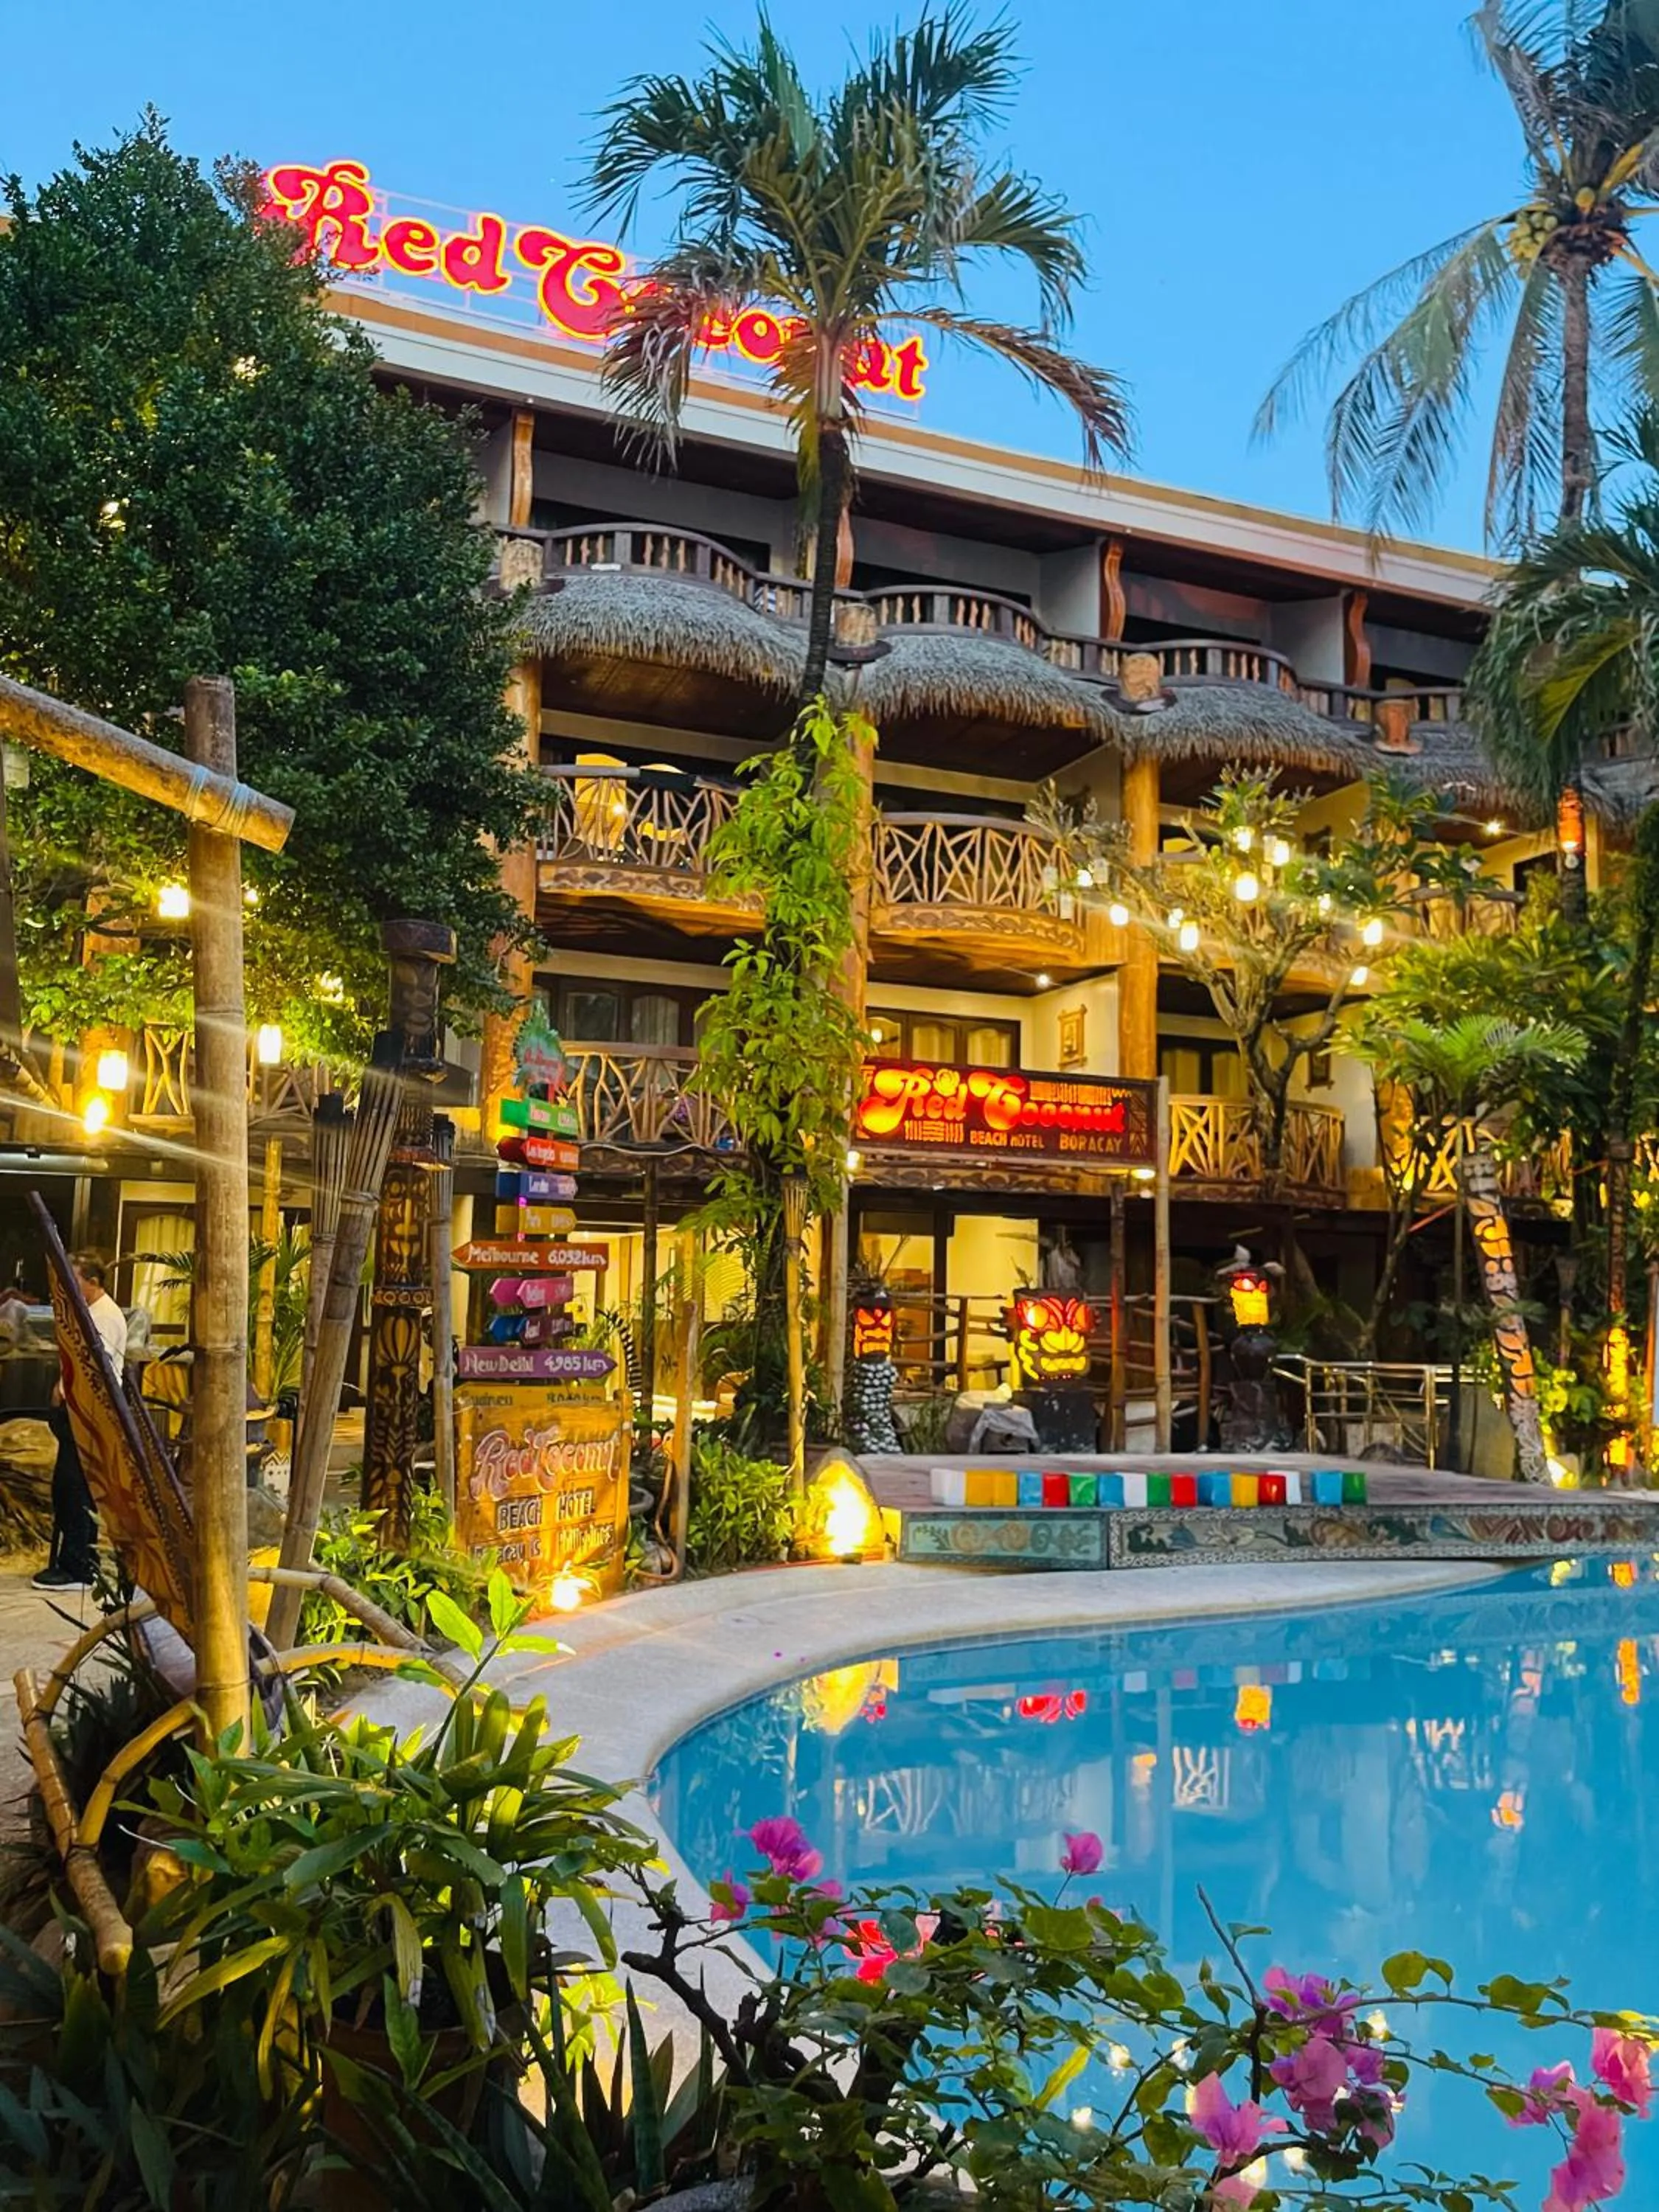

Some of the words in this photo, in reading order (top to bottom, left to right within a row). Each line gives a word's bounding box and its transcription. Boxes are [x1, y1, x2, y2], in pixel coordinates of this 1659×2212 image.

[262, 159, 510, 293] Red
[859, 1067, 967, 1133] Red
[970, 1131, 1007, 1147] BEACH
[1010, 1134, 1045, 1150] HOTEL
[1060, 1133, 1122, 1155] BORACAY
[466, 1243, 539, 1264] Melbourne
[465, 1351, 498, 1374] New
[498, 1354, 534, 1372] Delhi
[469, 1428, 534, 1502] Red
[557, 1488, 594, 1521] HOTEL
